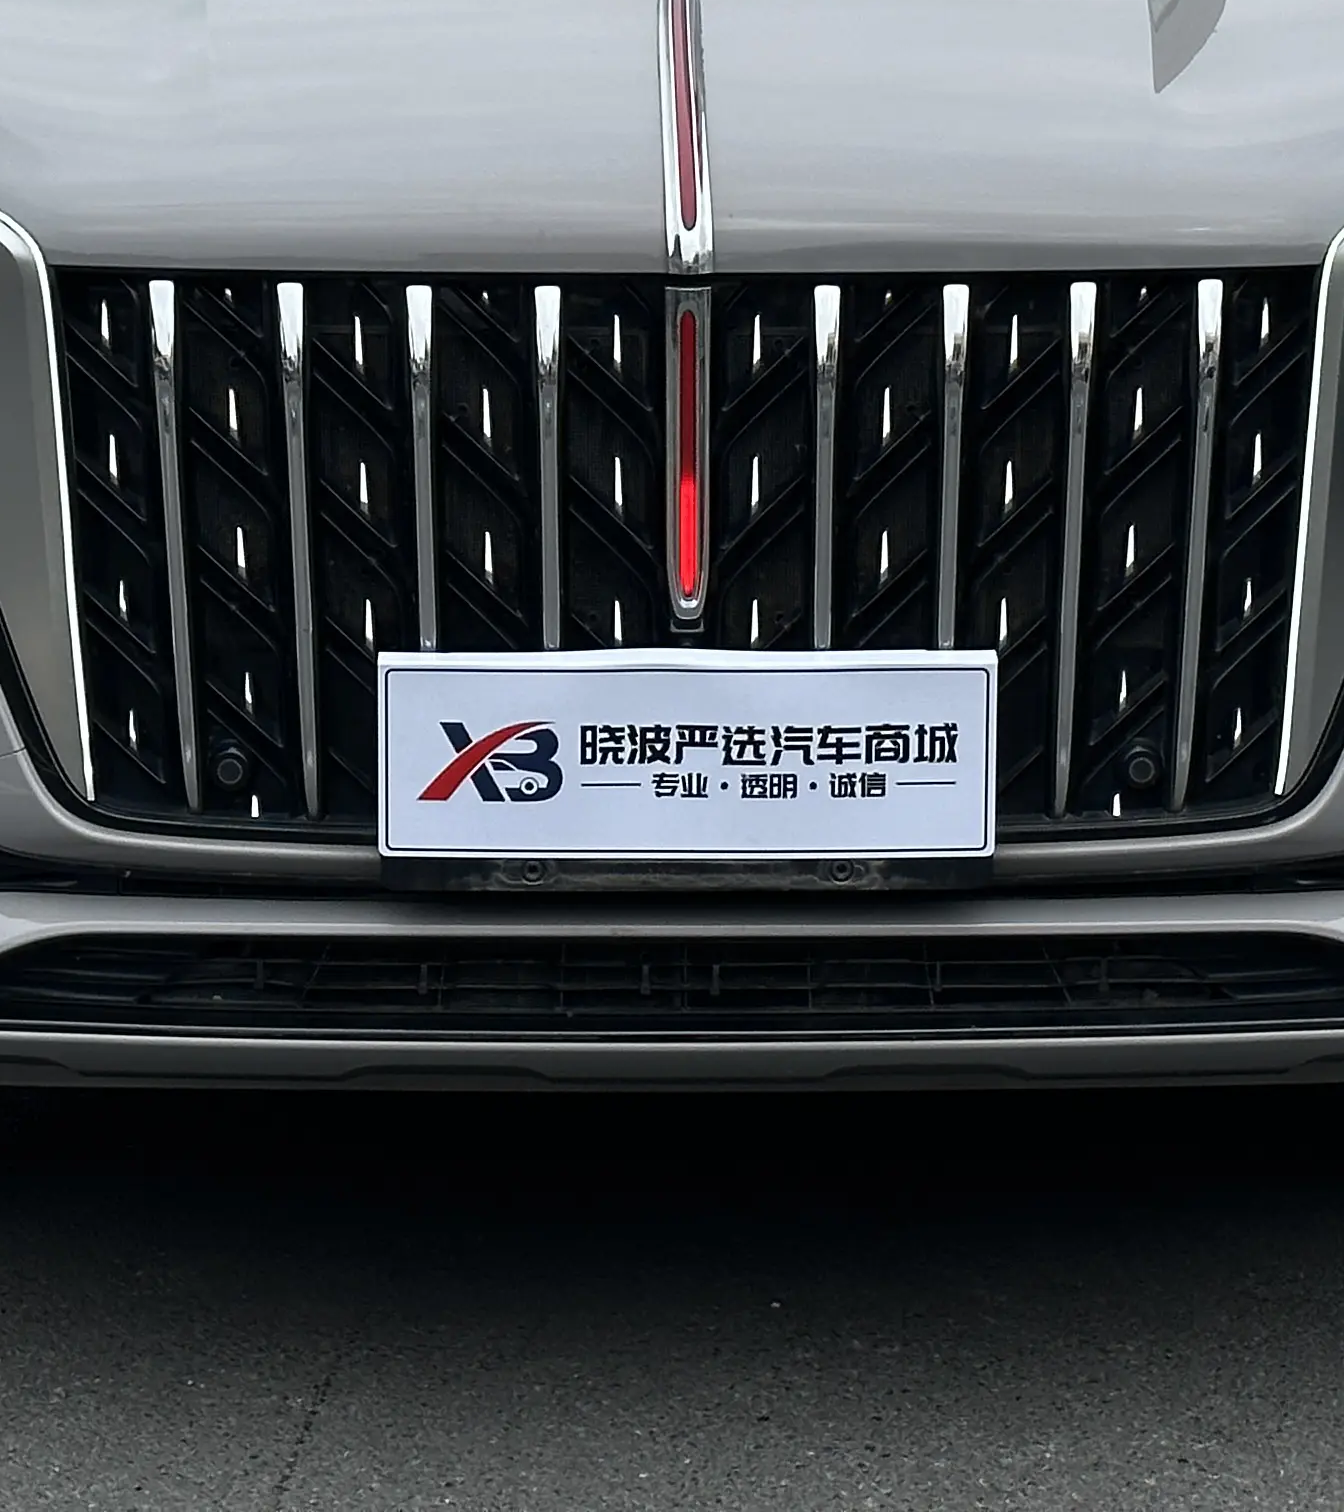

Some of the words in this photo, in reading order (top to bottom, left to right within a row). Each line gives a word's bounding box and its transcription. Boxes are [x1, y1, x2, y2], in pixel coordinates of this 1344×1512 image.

[578, 722, 960, 766] 晓波严选汽车商城
